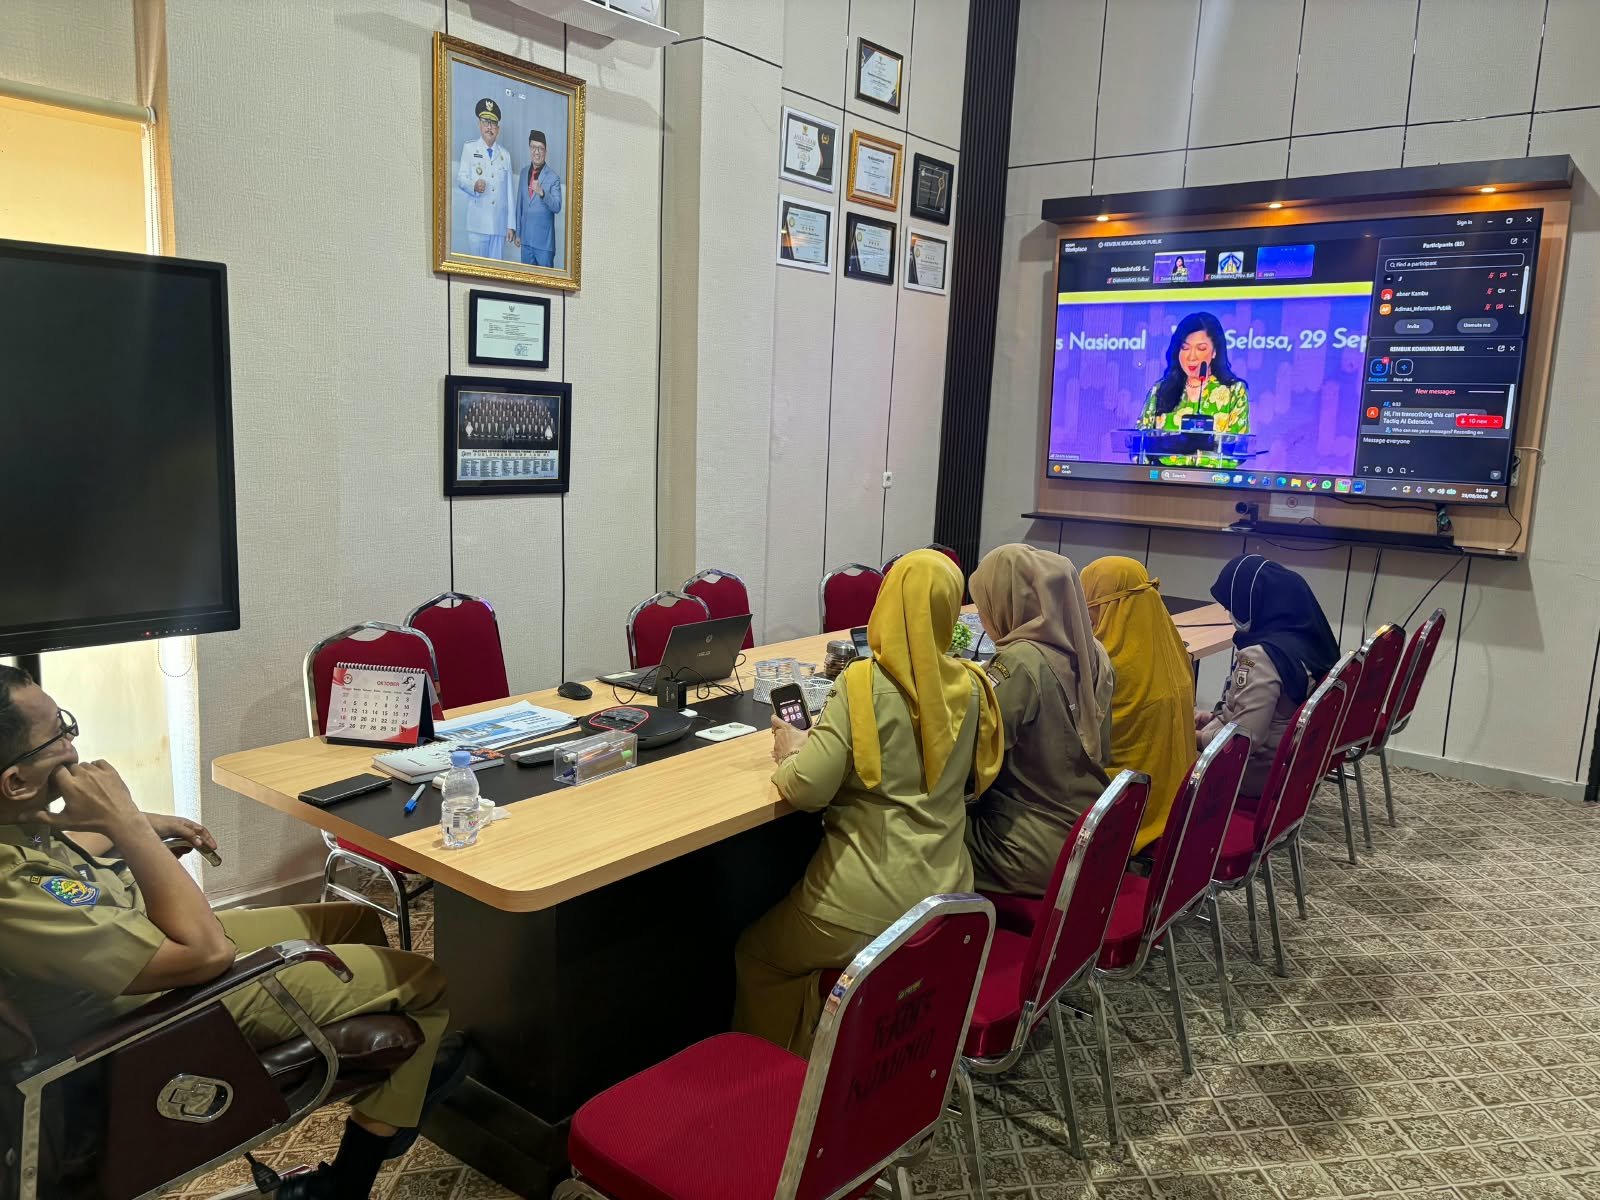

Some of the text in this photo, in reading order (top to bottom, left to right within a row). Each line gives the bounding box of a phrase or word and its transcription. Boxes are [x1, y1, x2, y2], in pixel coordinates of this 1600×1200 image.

[1070, 330, 1146, 351] Nasional
[1225, 329, 1292, 352] Selasa,
[1300, 330, 1327, 349] 29
